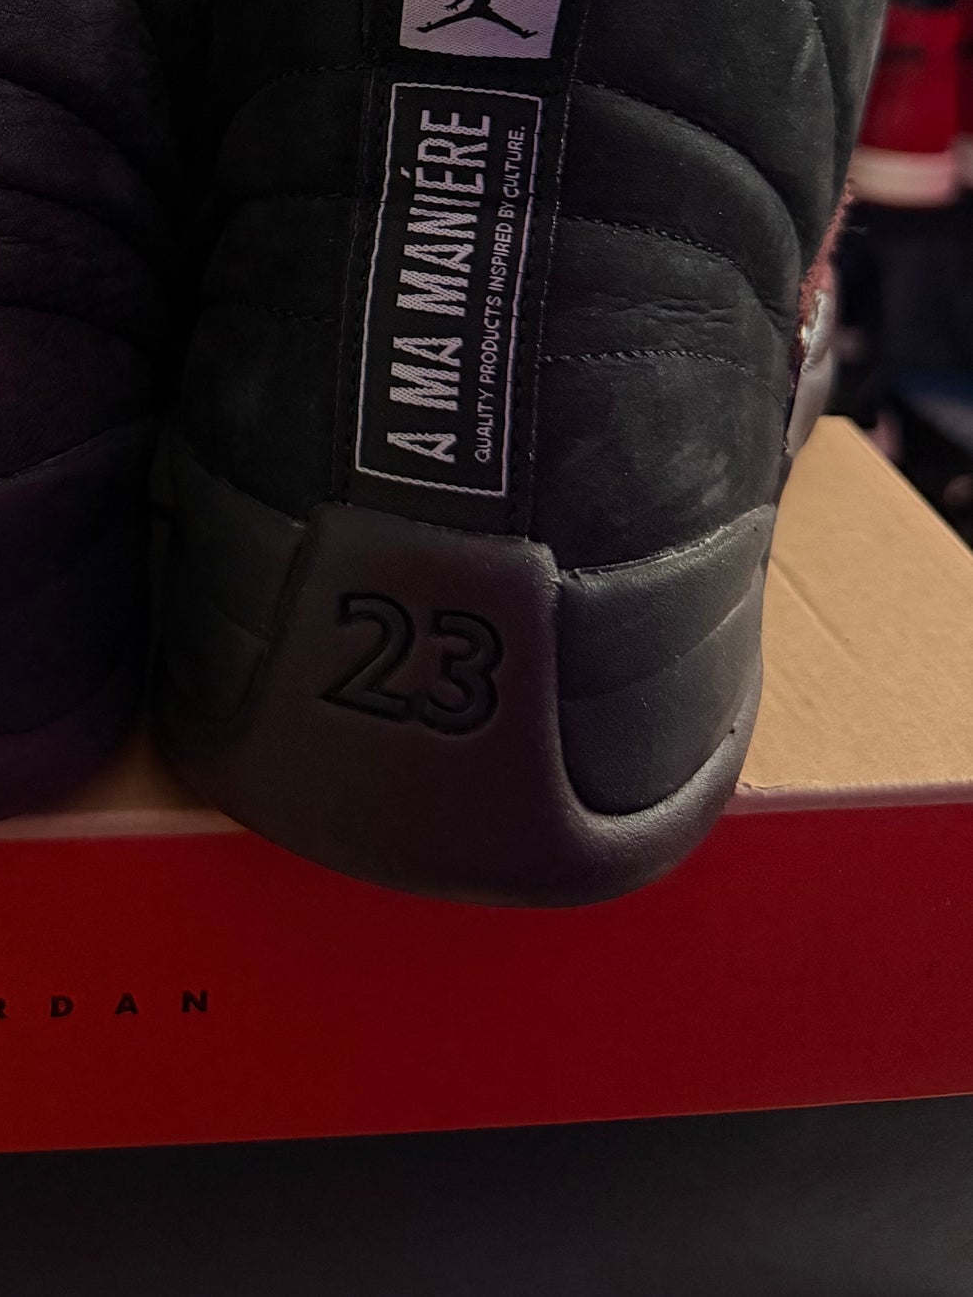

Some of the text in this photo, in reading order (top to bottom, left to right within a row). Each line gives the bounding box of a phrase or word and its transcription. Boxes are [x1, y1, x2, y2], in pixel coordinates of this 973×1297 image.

[474, 125, 527, 463] QUALITY PRODUCTS INSPIRED BY CULTURE.
[389, 335, 464, 411] MA
[386, 431, 457, 463] A
[319, 592, 504, 735] 23
